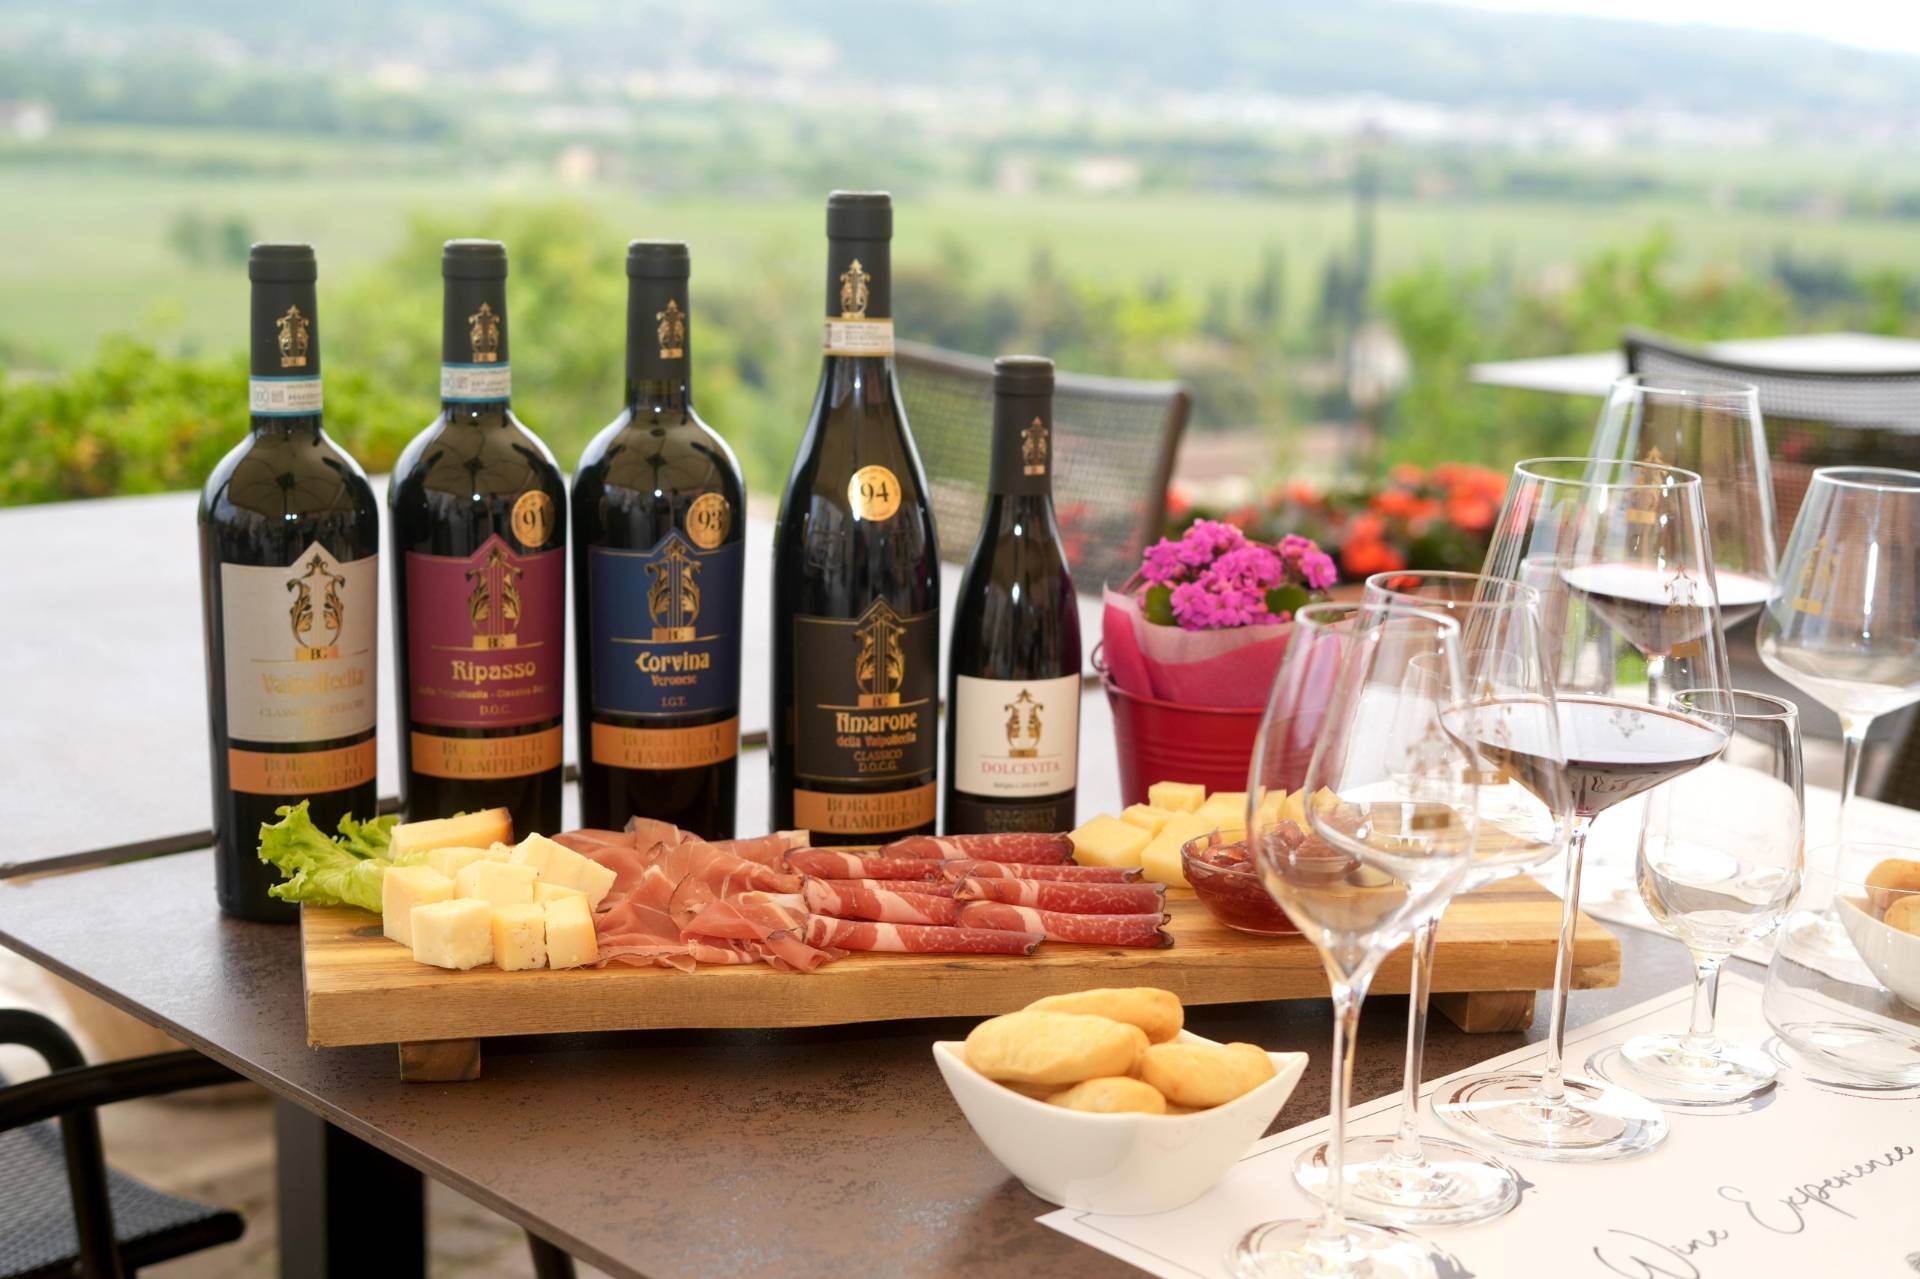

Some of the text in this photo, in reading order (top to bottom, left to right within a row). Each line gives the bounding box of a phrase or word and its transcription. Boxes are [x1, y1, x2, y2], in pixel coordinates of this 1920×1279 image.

[860, 480, 890, 504] 94
[522, 507, 547, 530] 91
[698, 508, 723, 531] 93
[450, 659, 537, 686] Ripasso
[635, 650, 711, 672] Corvina
[836, 711, 919, 733] Amarone
[981, 760, 1061, 775] DOLCEVITA
[1592, 1145, 1914, 1279] Wine Experience
